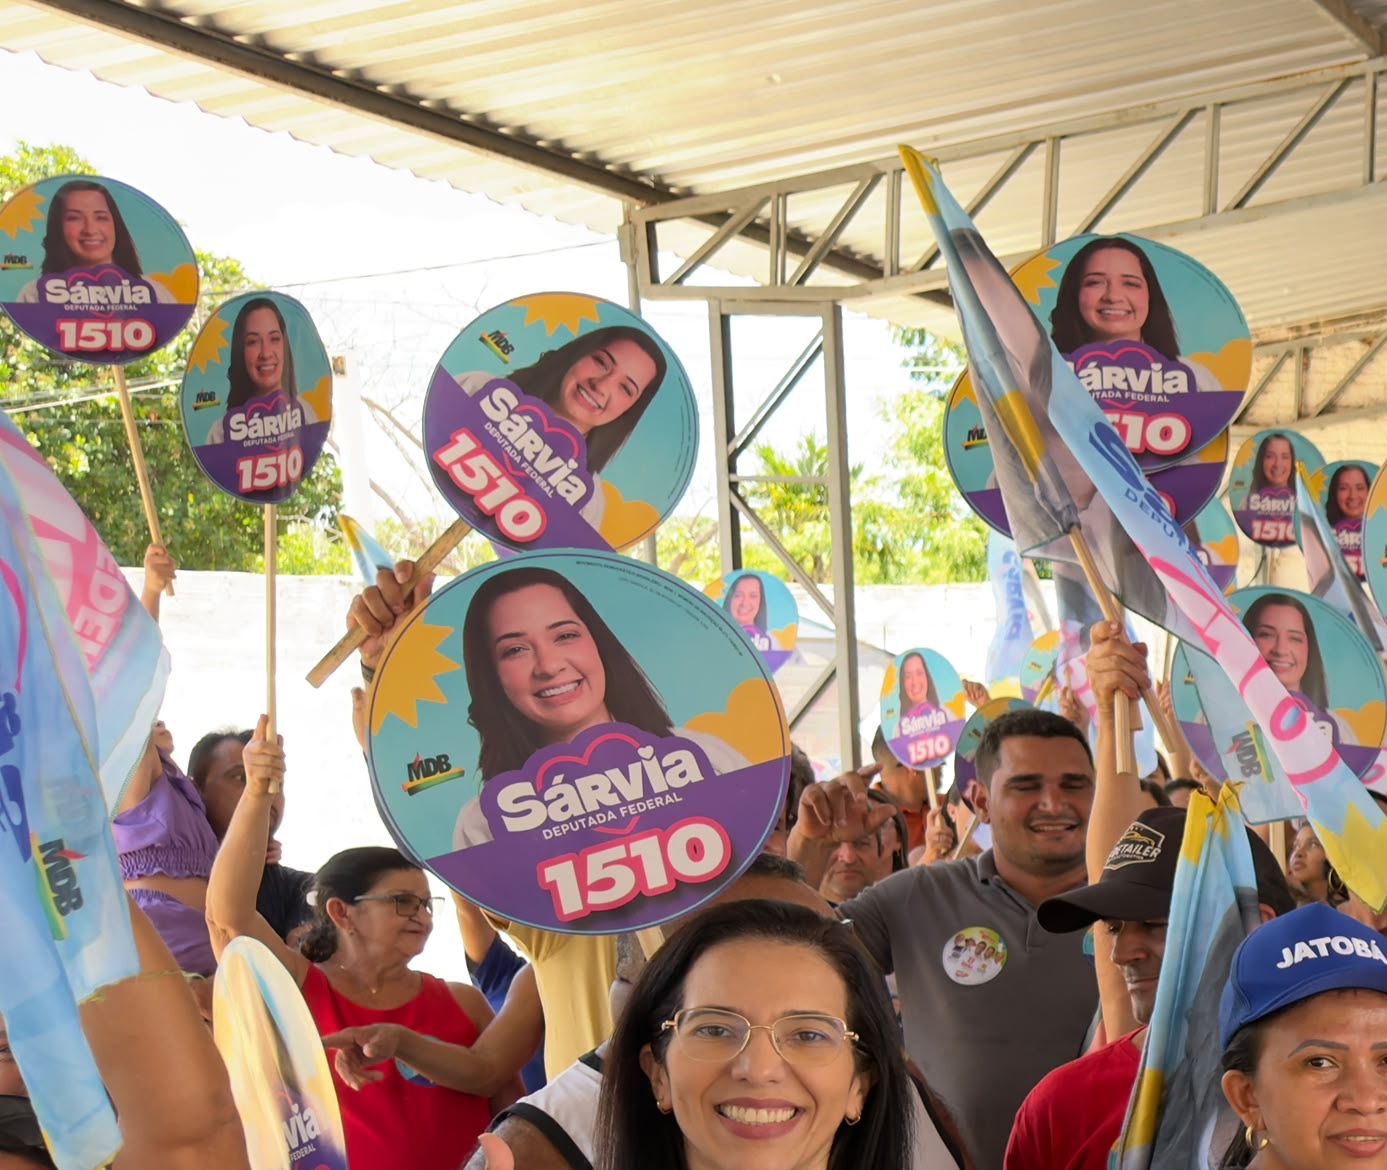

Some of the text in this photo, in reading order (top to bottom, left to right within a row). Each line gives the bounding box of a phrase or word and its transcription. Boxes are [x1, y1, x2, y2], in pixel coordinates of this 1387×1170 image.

[45, 278, 151, 305] Sárvia
[59, 321, 154, 349] 1510
[230, 403, 301, 439] Sárvia
[1125, 391, 1170, 402] FEDERAL
[238, 450, 301, 489] 1510
[480, 387, 587, 506] Sárvia
[484, 422, 554, 498] DEPUTADA FEDERAL
[437, 433, 542, 538] 1510
[497, 745, 704, 832] Sárvia
[542, 792, 683, 840] DEPUTADA FEDERAL
[40, 838, 83, 918] MDB
[545, 822, 725, 915] 1510
